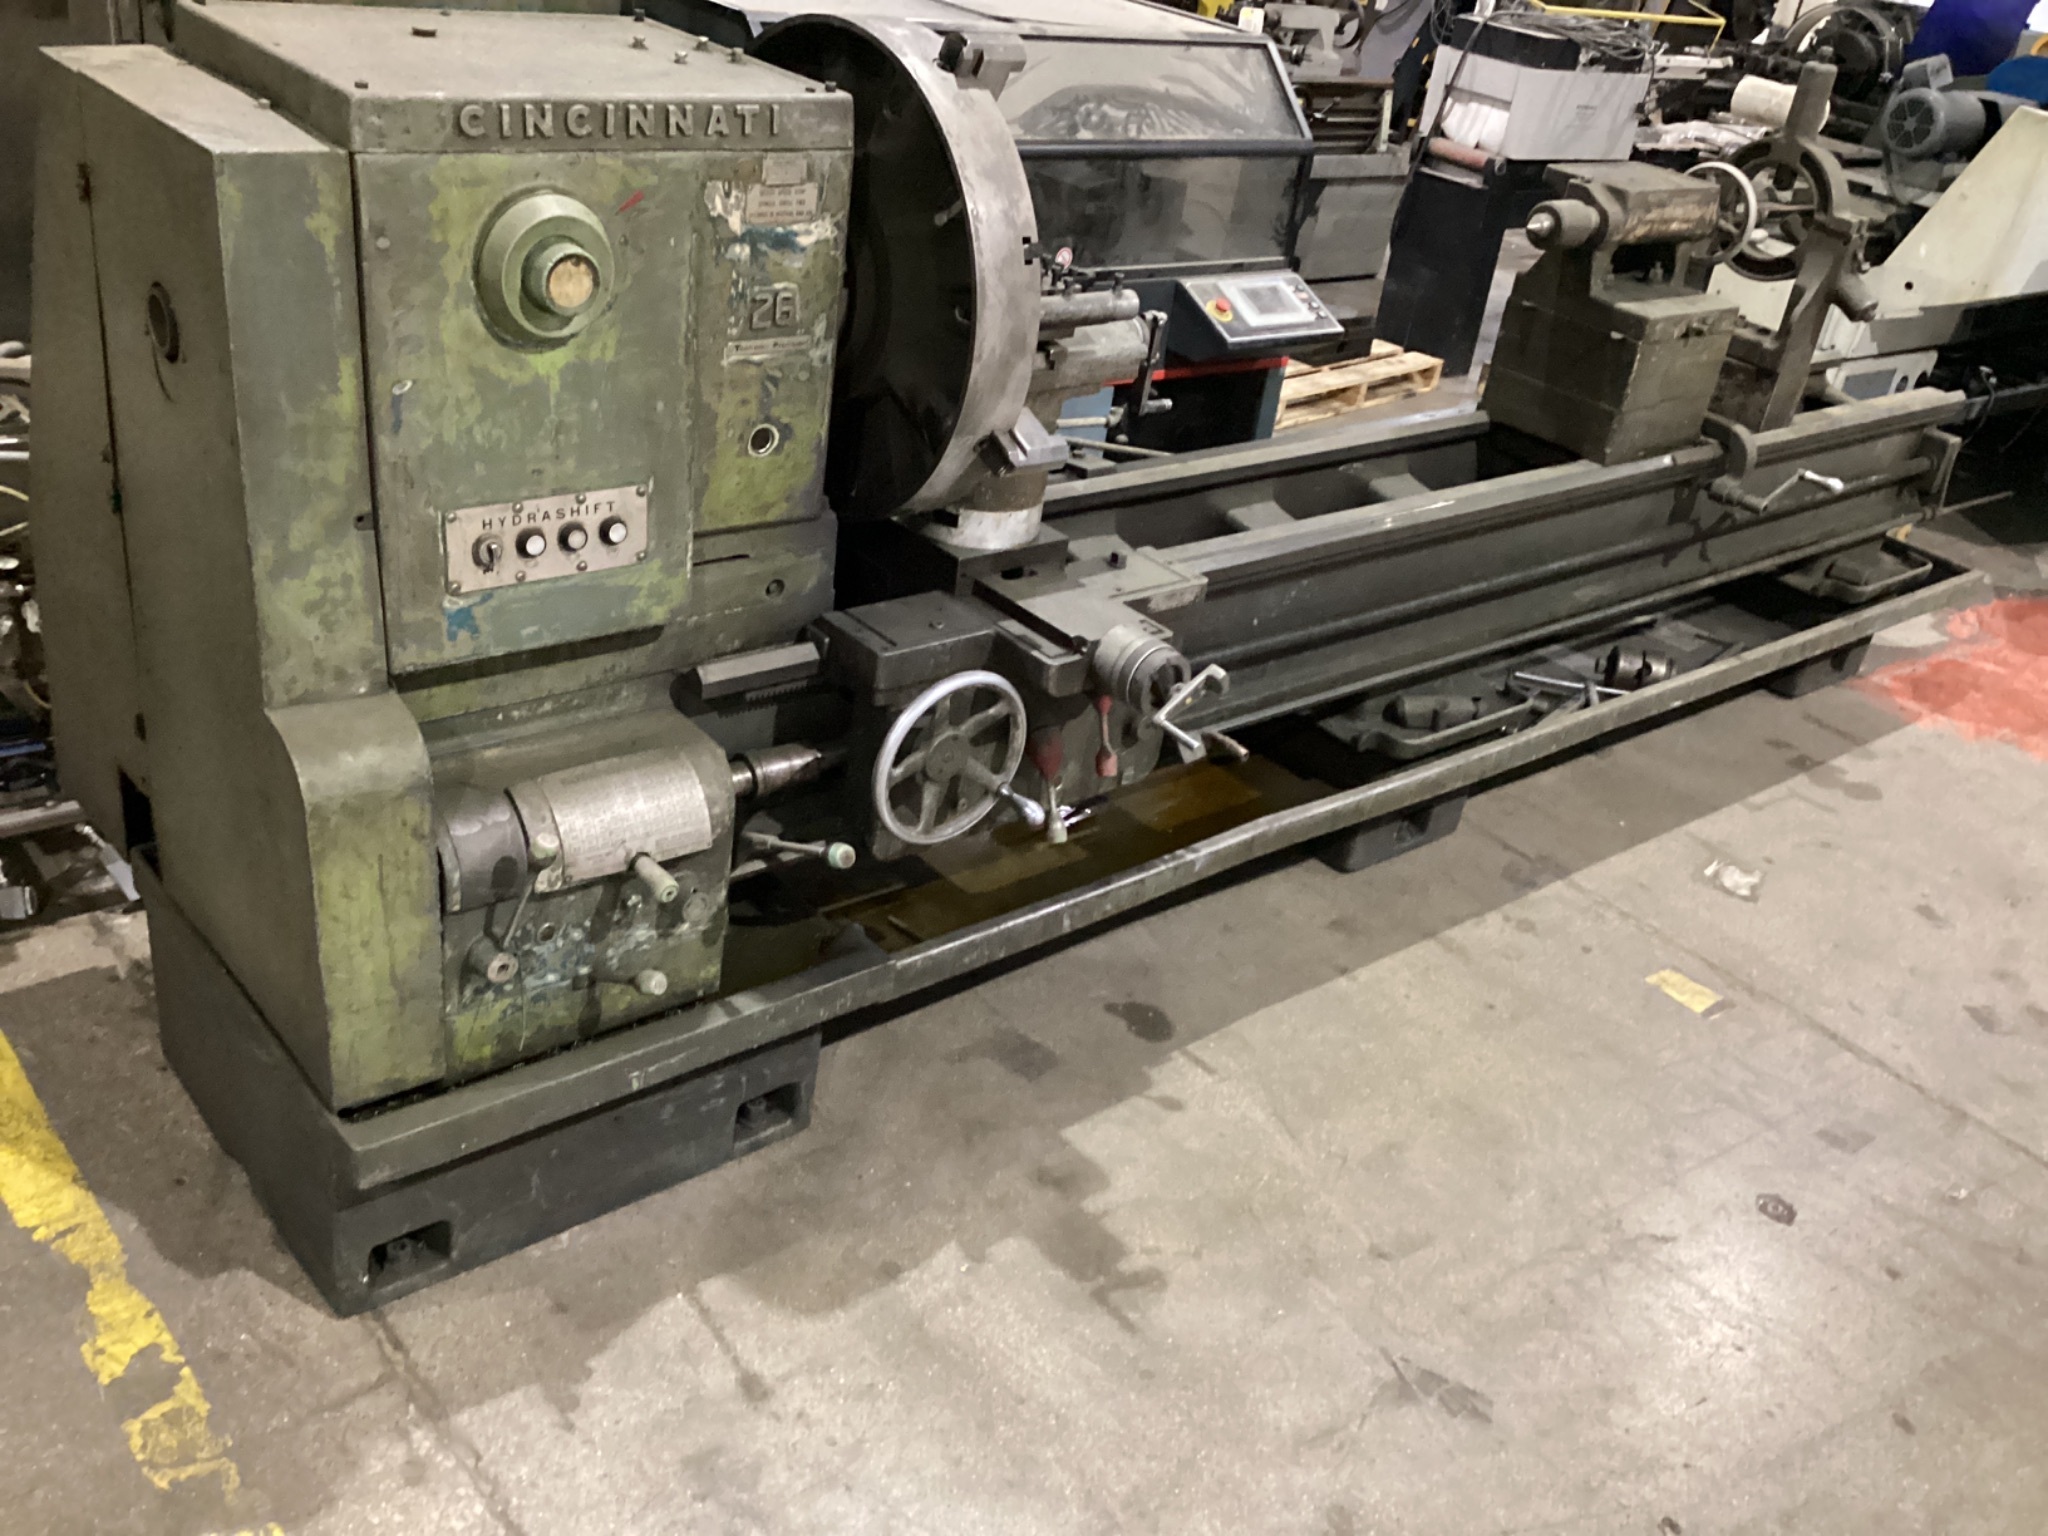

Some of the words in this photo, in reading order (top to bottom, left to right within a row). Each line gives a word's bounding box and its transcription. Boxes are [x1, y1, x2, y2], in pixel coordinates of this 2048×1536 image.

[459, 103, 780, 137] CINCINNATI
[750, 292, 796, 329] 26
[482, 501, 616, 530] HYDRASHIFT
